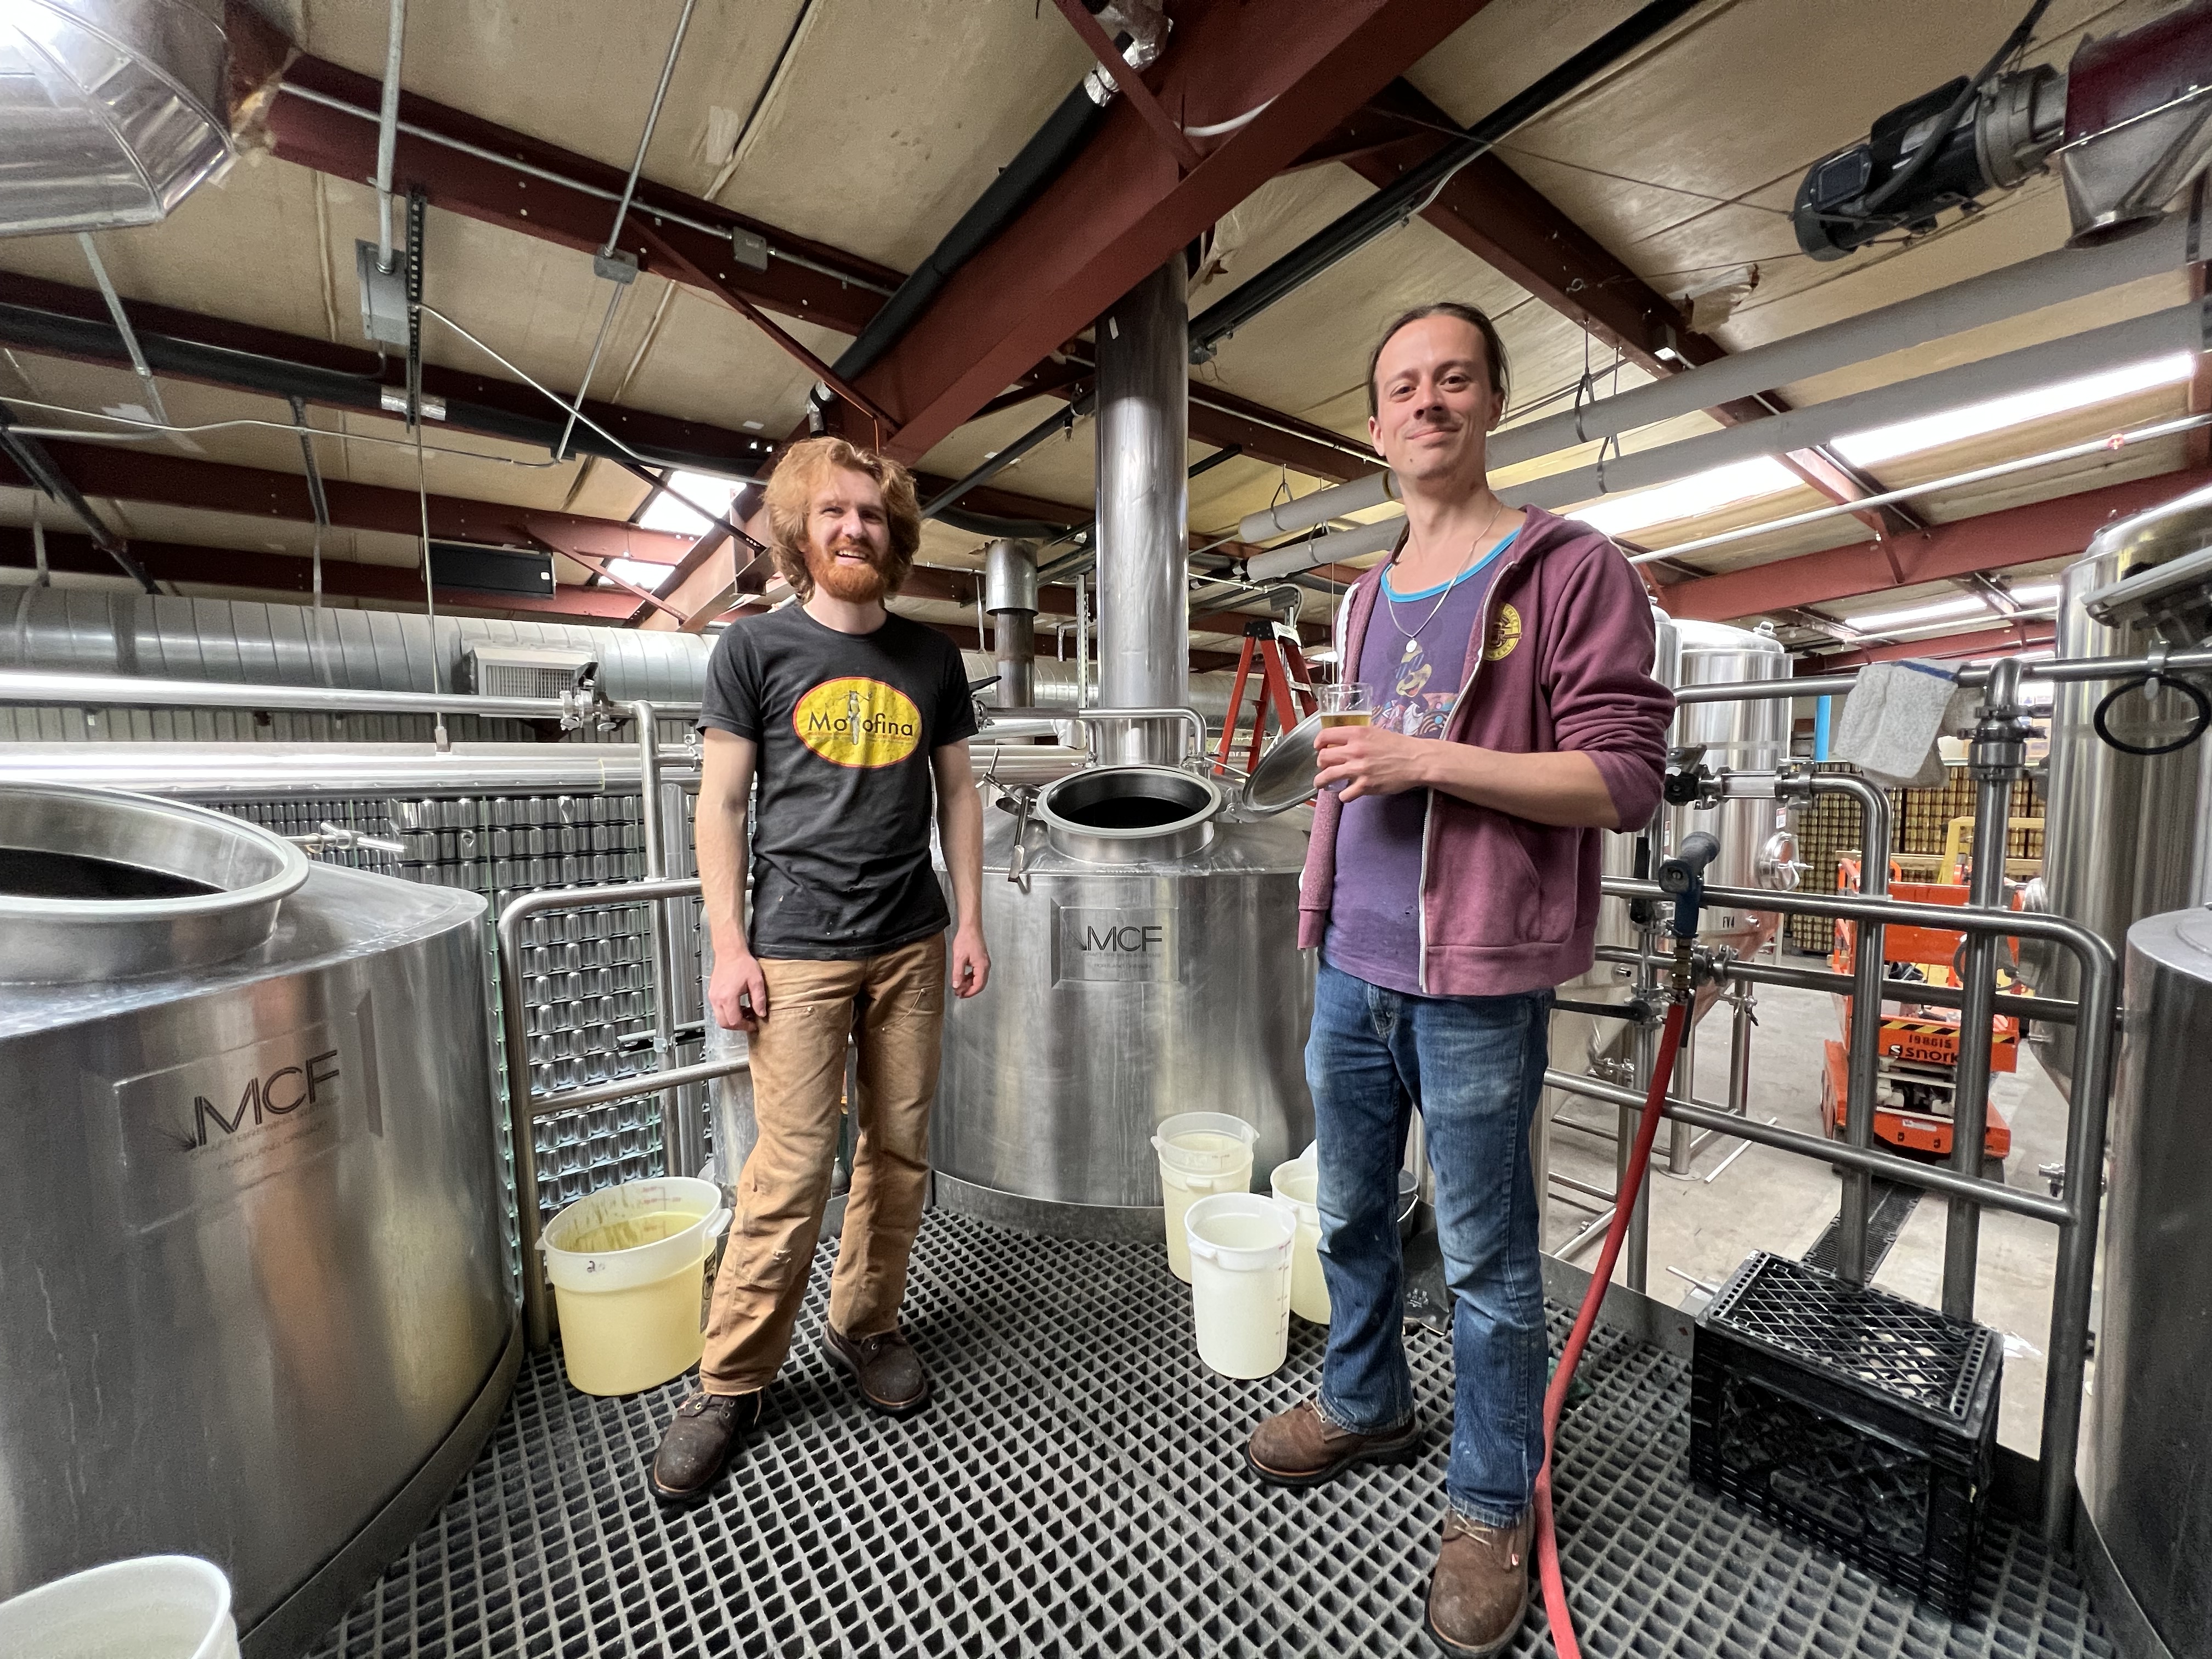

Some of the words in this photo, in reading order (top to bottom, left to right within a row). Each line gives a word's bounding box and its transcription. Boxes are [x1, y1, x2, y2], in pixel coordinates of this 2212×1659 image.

[1723, 916, 1735, 928] FV4
[1087, 926, 1163, 952] MCF
[194, 1049, 340, 1147] MCF
